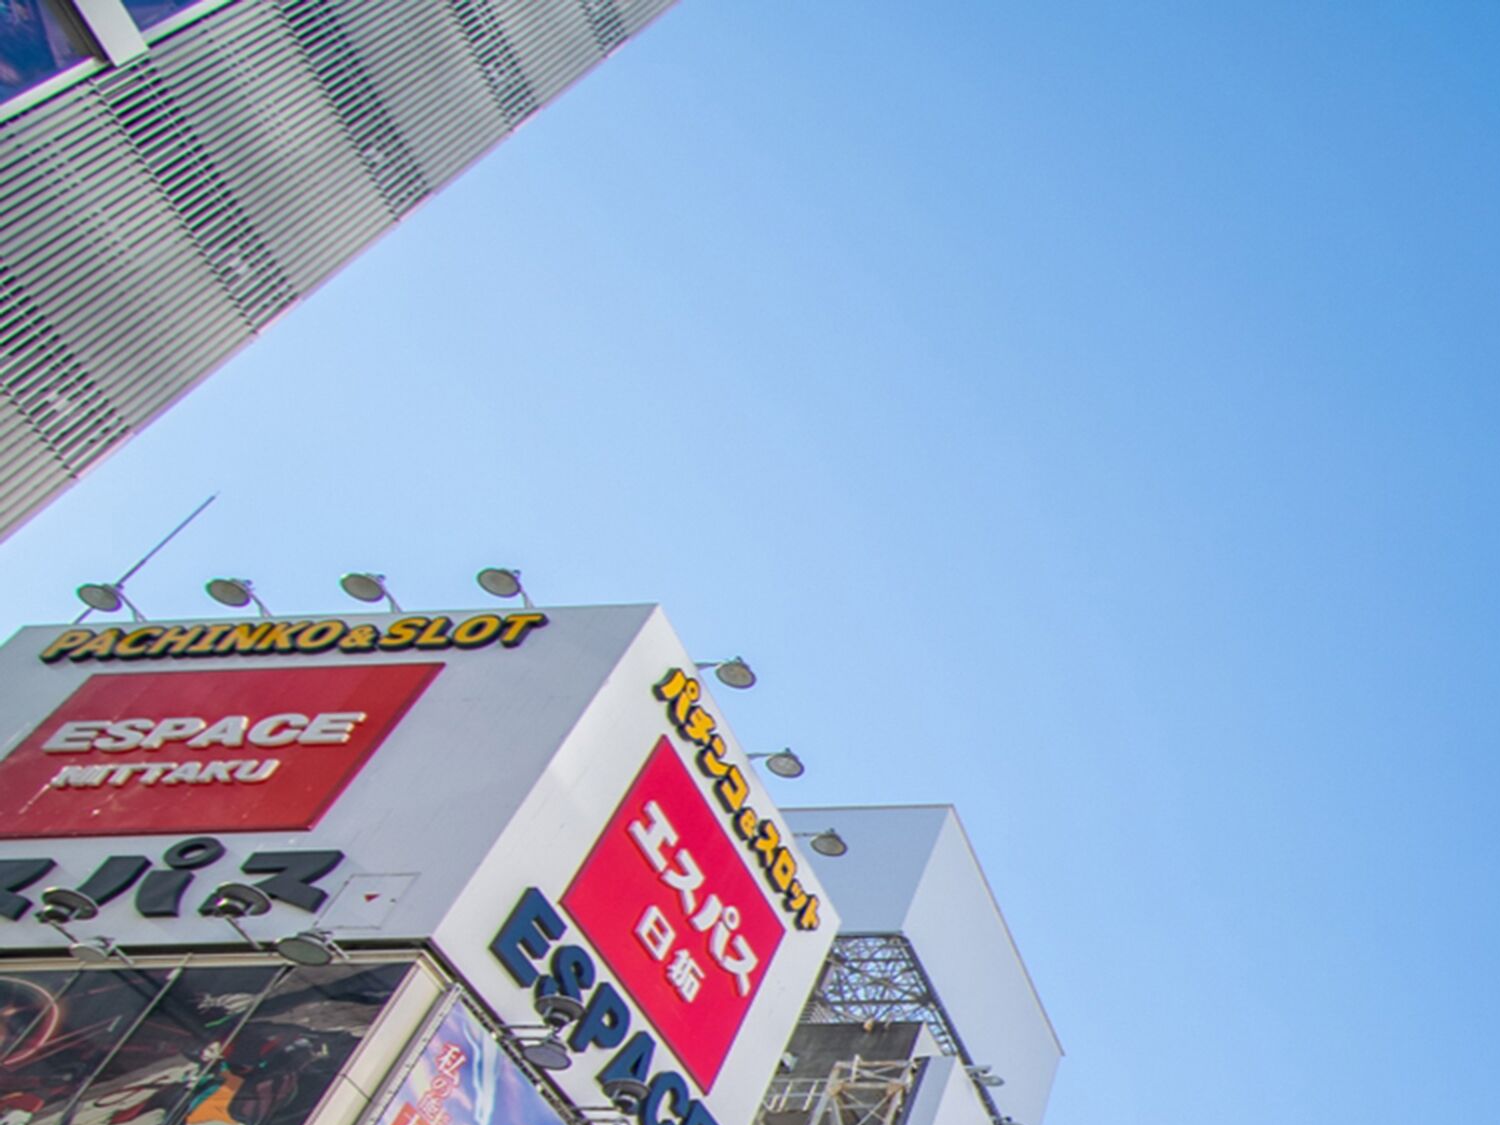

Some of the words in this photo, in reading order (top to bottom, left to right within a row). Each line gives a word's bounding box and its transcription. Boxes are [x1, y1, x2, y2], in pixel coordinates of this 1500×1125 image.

[40, 611, 550, 664] PACHINKO&SLOT
[41, 711, 369, 755] ESPACE
[48, 757, 282, 790] NITTAKU
[653, 668, 825, 931] パチンコ&スロット
[626, 801, 760, 998] エスパス
